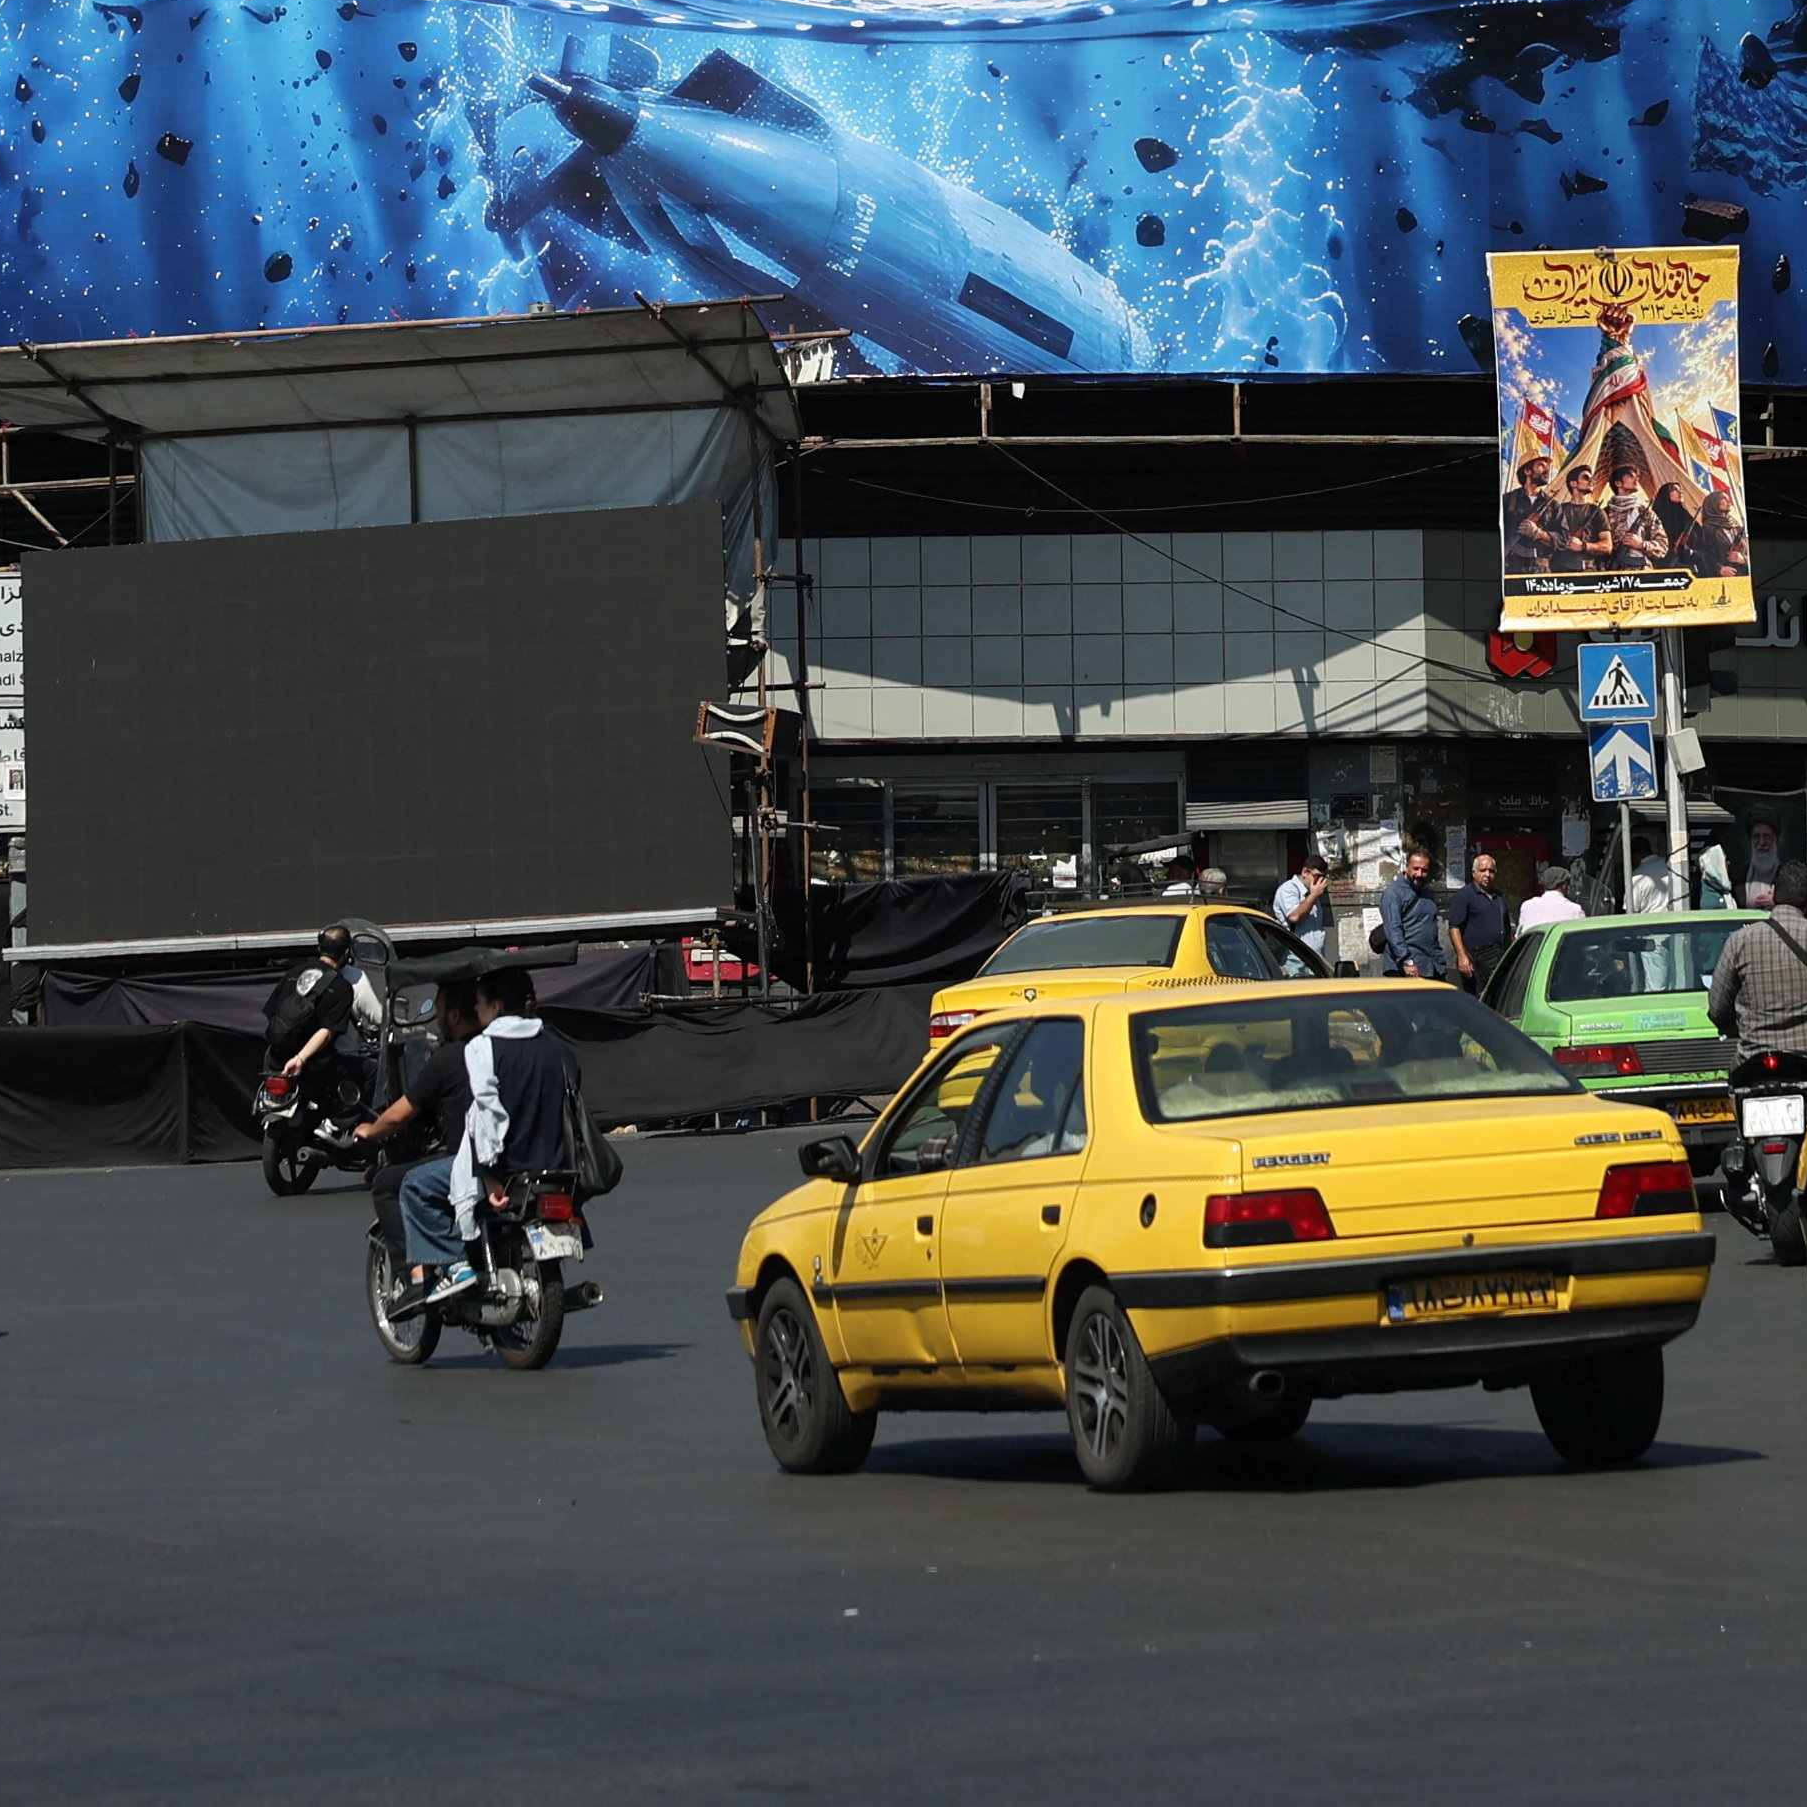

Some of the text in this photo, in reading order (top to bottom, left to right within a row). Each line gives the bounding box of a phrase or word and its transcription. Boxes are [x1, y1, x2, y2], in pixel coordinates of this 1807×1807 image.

[1557, 309, 1591, 324] هزار
[1665, 304, 1705, 321] رزمایش
[1525, 578, 1549, 592] ۱۴۰۵
[1620, 575, 1634, 589] ۲۷
[1633, 576, 1690, 590] جمعه
[1526, 599, 1555, 618] ایران
[1252, 1151, 1331, 1169] PEUGEOT
